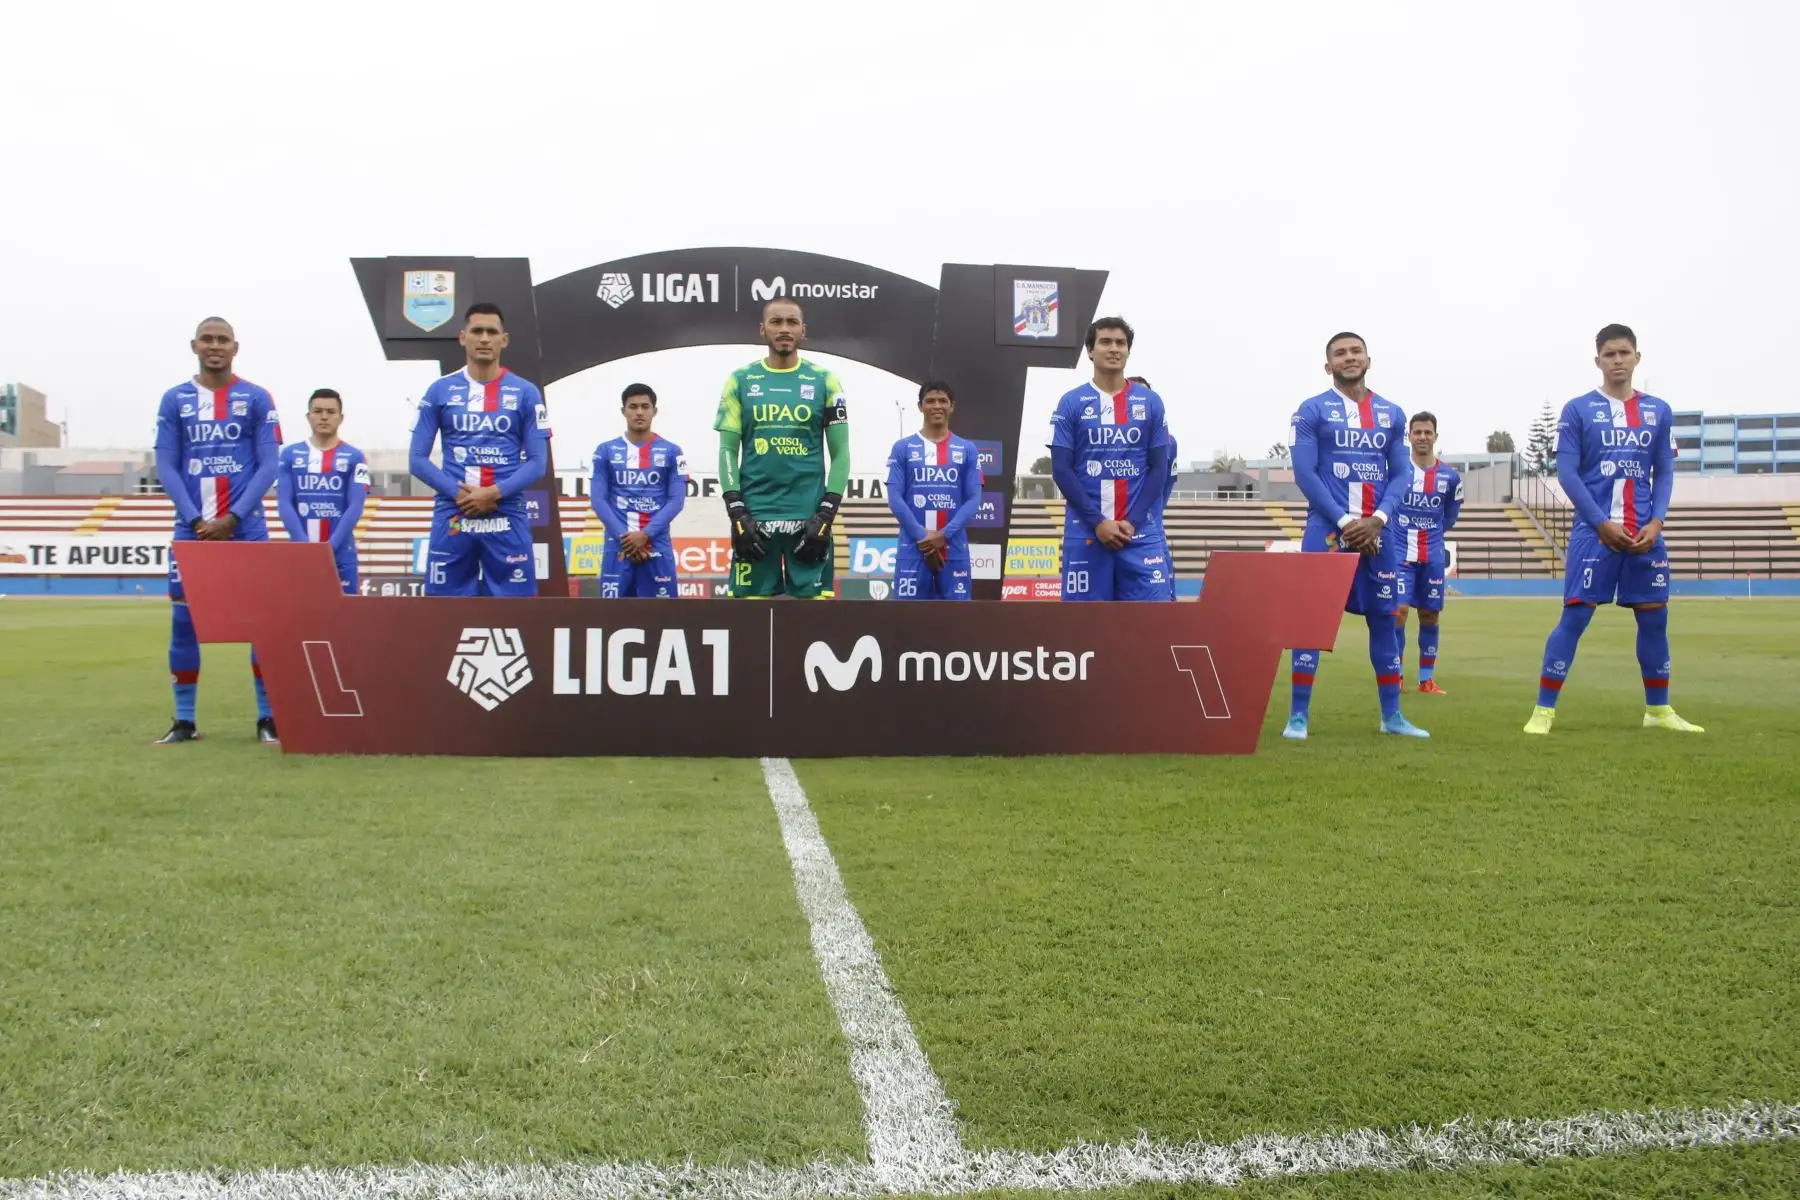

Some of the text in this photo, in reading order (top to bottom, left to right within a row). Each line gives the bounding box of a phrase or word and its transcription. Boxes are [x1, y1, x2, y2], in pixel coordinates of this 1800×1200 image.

[791, 281, 879, 299] movistar
[752, 403, 812, 422] UPAO
[452, 414, 512, 433] UPAO
[186, 422, 242, 443] UPAO
[1087, 426, 1142, 445] UPAO
[1334, 430, 1387, 449] UPAO
[1601, 429, 1653, 447] UPAO
[770, 436, 799, 446] casa
[776, 442, 809, 456] verde
[468, 445, 501, 455] casa
[203, 455, 233, 465] casa
[207, 461, 243, 474] verde
[1104, 459, 1131, 469] casa
[1351, 462, 1378, 472] casa
[616, 471, 660, 485] UPAO
[914, 467, 958, 483] UPAO
[1109, 464, 1140, 477] verde
[1357, 469, 1384, 481] verde
[297, 475, 343, 491] UPAO
[928, 492, 951, 502] casa
[932, 498, 957, 509] verde
[29, 545, 172, 565] TE APUEST
[1007, 545, 1056, 556] APUESTA
[1010, 558, 1053, 570] EN VIVO
[429, 561, 447, 585] 16
[734, 562, 752, 586] 12
[1583, 567, 1593, 589] 3
[677, 583, 705, 597] IGA1
[899, 578, 917, 596] 26
[1066, 570, 1090, 594] 88
[898, 645, 1096, 682] movistar
